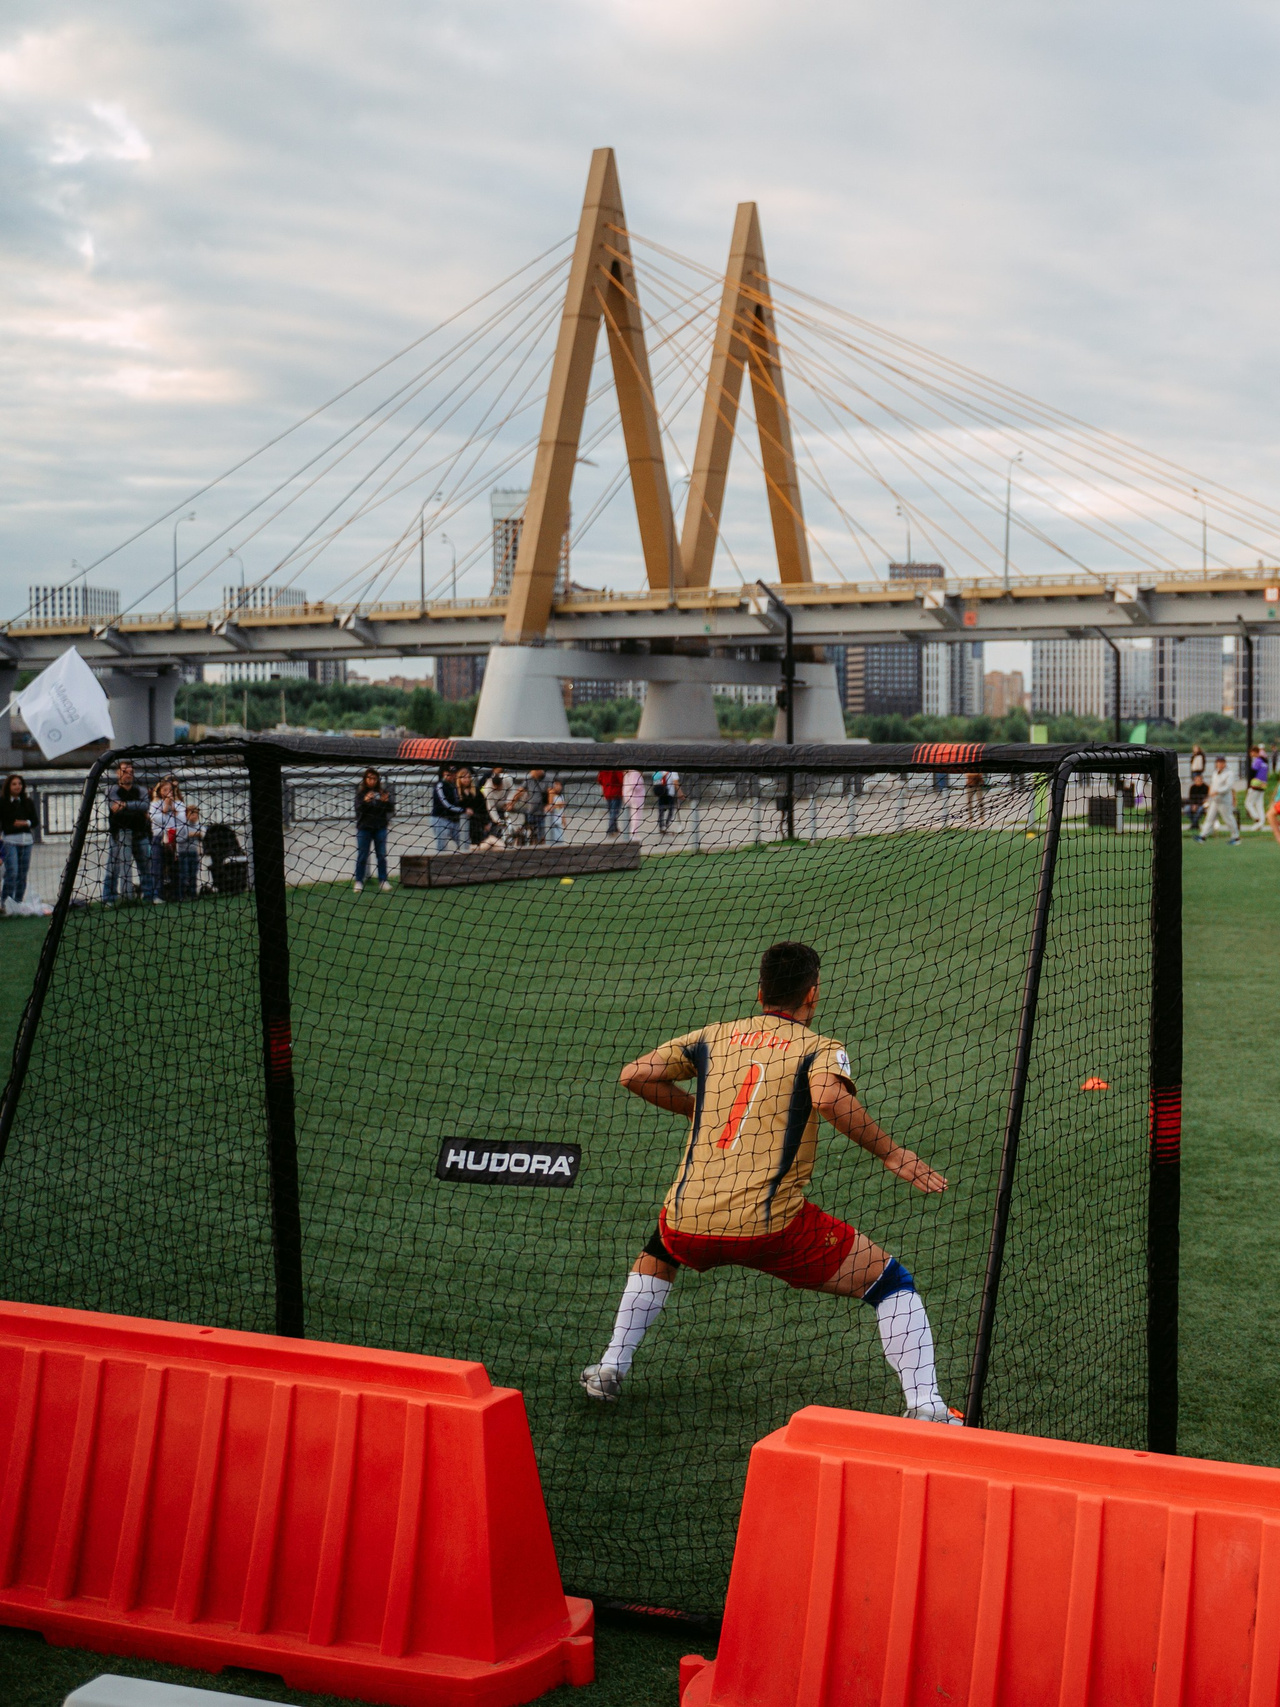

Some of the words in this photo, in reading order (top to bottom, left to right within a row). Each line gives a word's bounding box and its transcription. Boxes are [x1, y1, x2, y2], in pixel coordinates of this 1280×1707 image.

[730, 1028, 791, 1051] buffon
[716, 1060, 765, 1150] 1
[446, 1149, 571, 1176] HUDORA
